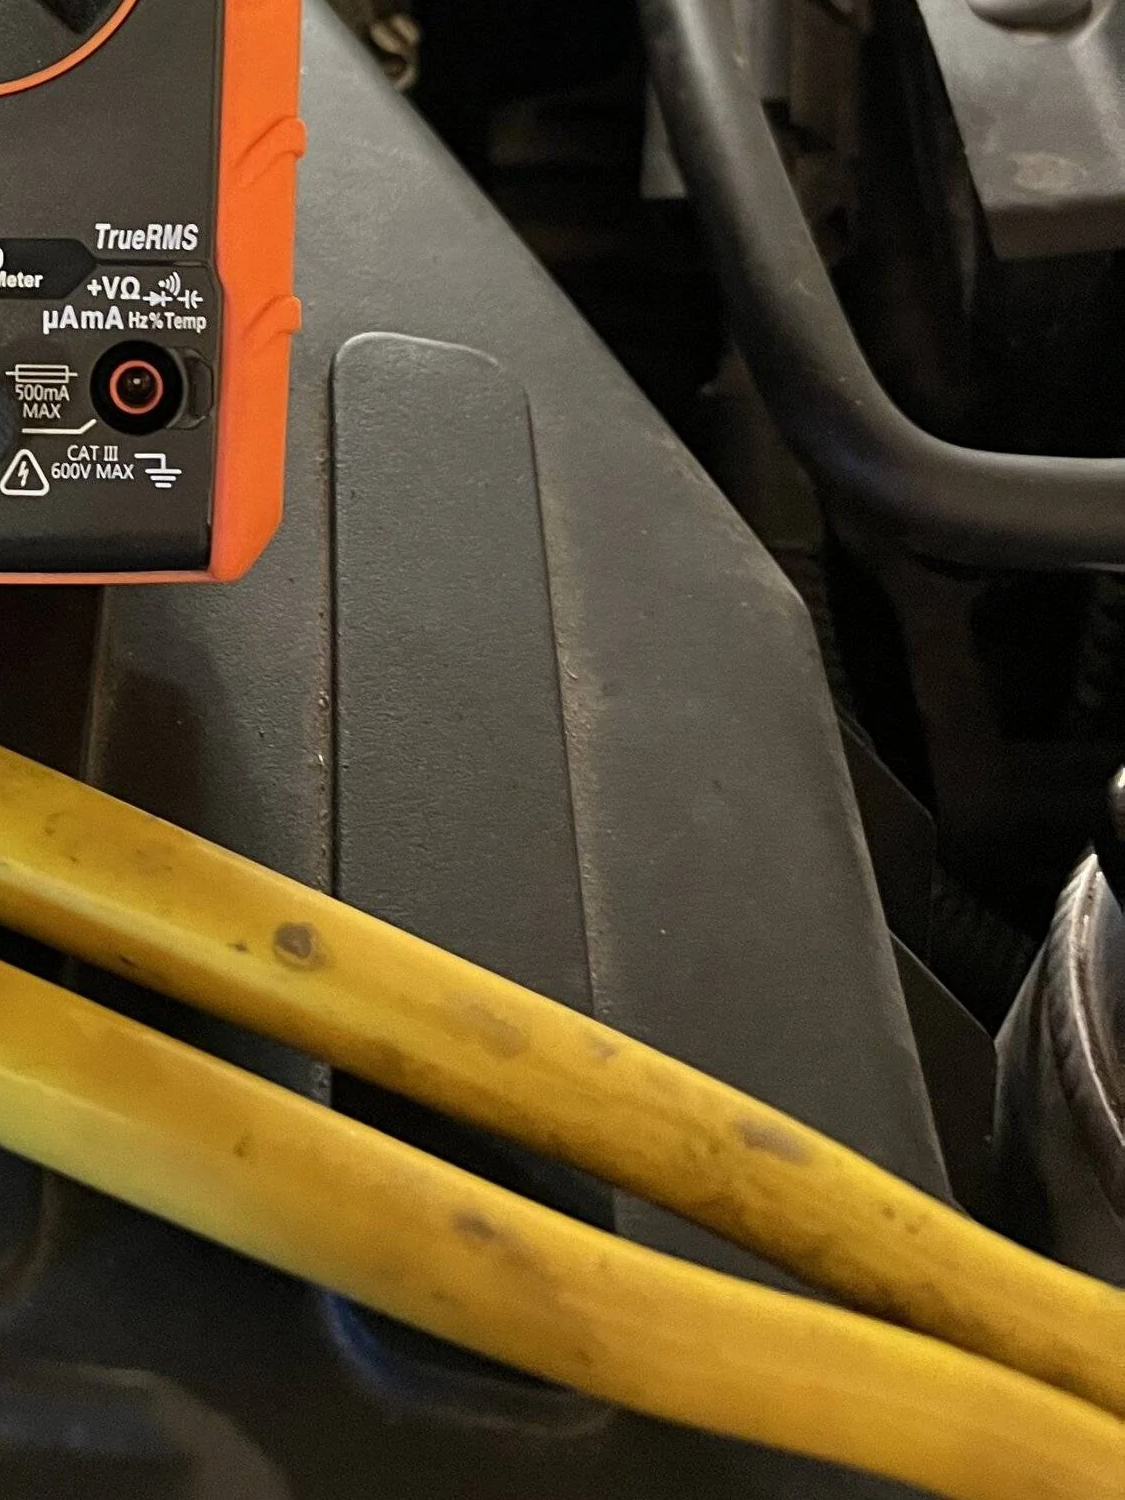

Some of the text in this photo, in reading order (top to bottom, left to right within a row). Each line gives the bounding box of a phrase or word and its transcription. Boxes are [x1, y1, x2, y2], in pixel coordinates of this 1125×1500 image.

[94, 223, 199, 251] TrueRMS
[15, 384, 70, 402] 500mA
[22, 403, 61, 419] MAX
[67, 445, 99, 461] CAT
[51, 463, 135, 480] 600V MAX
